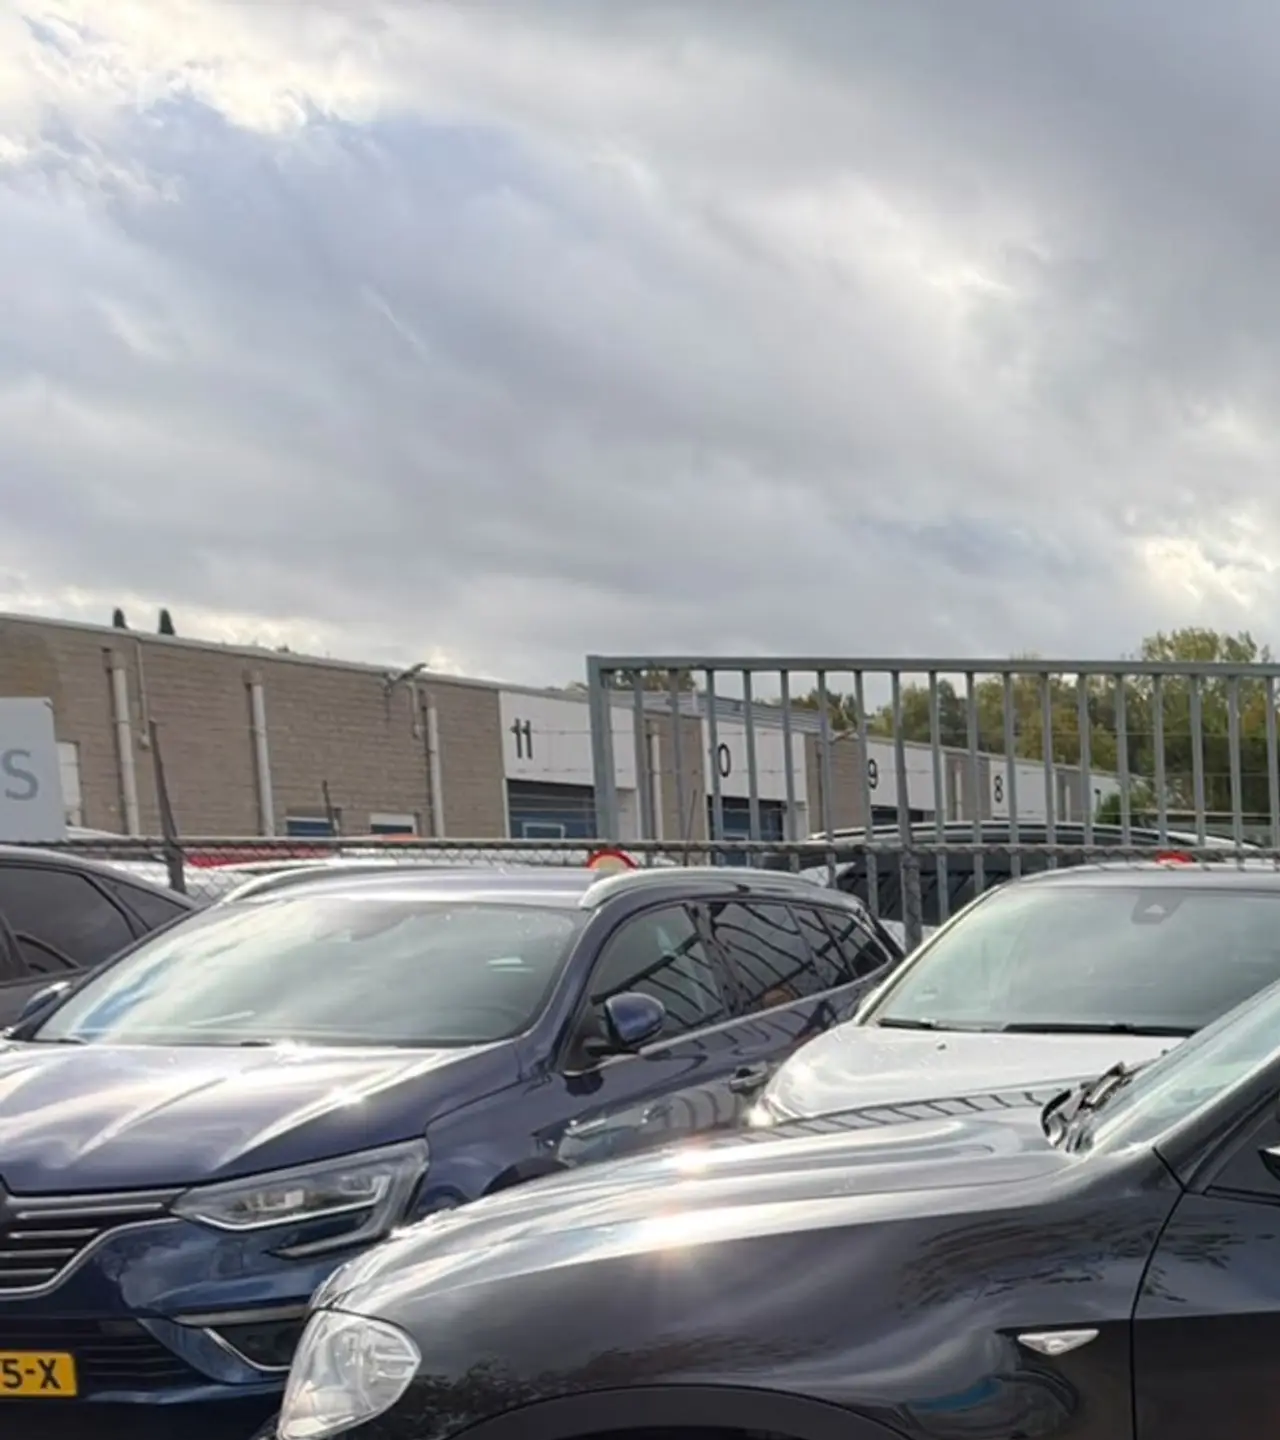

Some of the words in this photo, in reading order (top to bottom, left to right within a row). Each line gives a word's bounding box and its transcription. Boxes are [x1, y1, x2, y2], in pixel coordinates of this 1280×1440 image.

[510, 718, 532, 760] 11
[868, 758, 879, 789] 9
[993, 775, 1004, 803] 8
